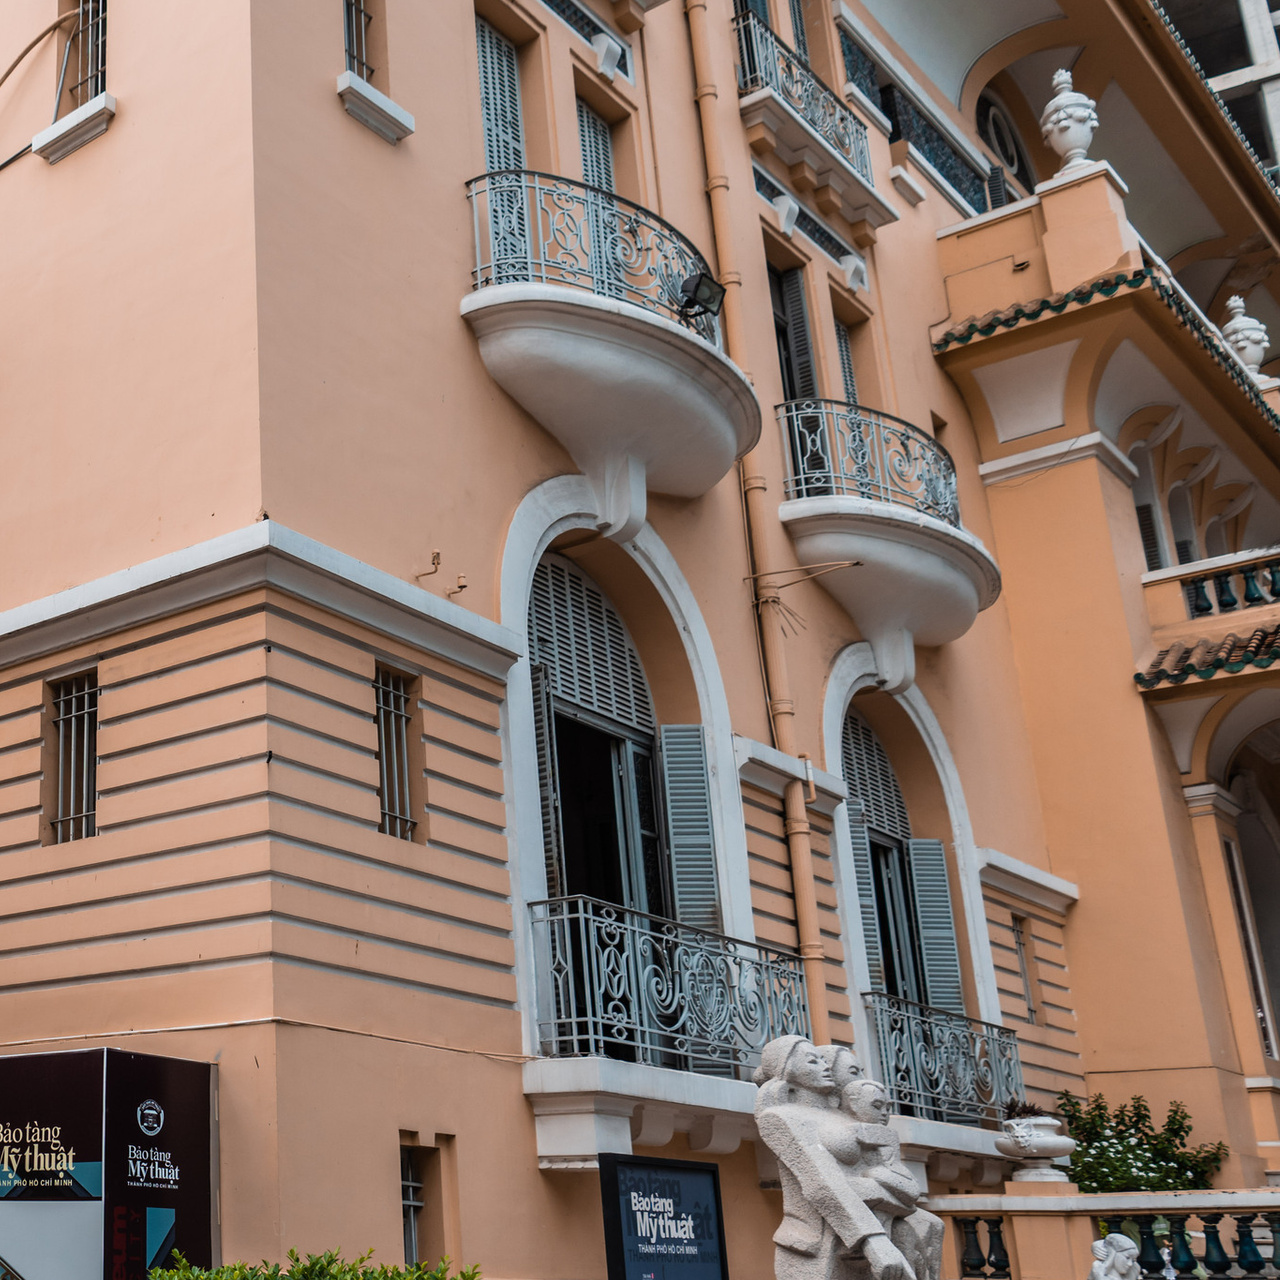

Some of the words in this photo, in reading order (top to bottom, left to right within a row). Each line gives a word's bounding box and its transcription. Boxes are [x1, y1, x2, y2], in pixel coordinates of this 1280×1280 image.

[25, 1121, 61, 1150] tàng
[24, 1144, 76, 1179] thuật
[128, 1145, 149, 1160] Bảo
[149, 1147, 171, 1167] tàng
[13, 1178, 27, 1187] PHỐ
[28, 1178, 39, 1187] HỒ
[40, 1177, 53, 1187] CHÍ
[54, 1179, 73, 1187] MINH
[127, 1160, 149, 1182] Mỹ
[149, 1161, 180, 1184] thuật
[630, 1191, 650, 1211] Bảo
[651, 1192, 674, 1218] tàng
[636, 1211, 658, 1244] Mỹ
[658, 1212, 695, 1244] thuật
[638, 1242, 656, 1254] THÀNH
[656, 1242, 667, 1254] PHỐ
[668, 1242, 676, 1254] HỒ
[676, 1242, 685, 1255] CHÍ
[685, 1246, 698, 1255] MINH
